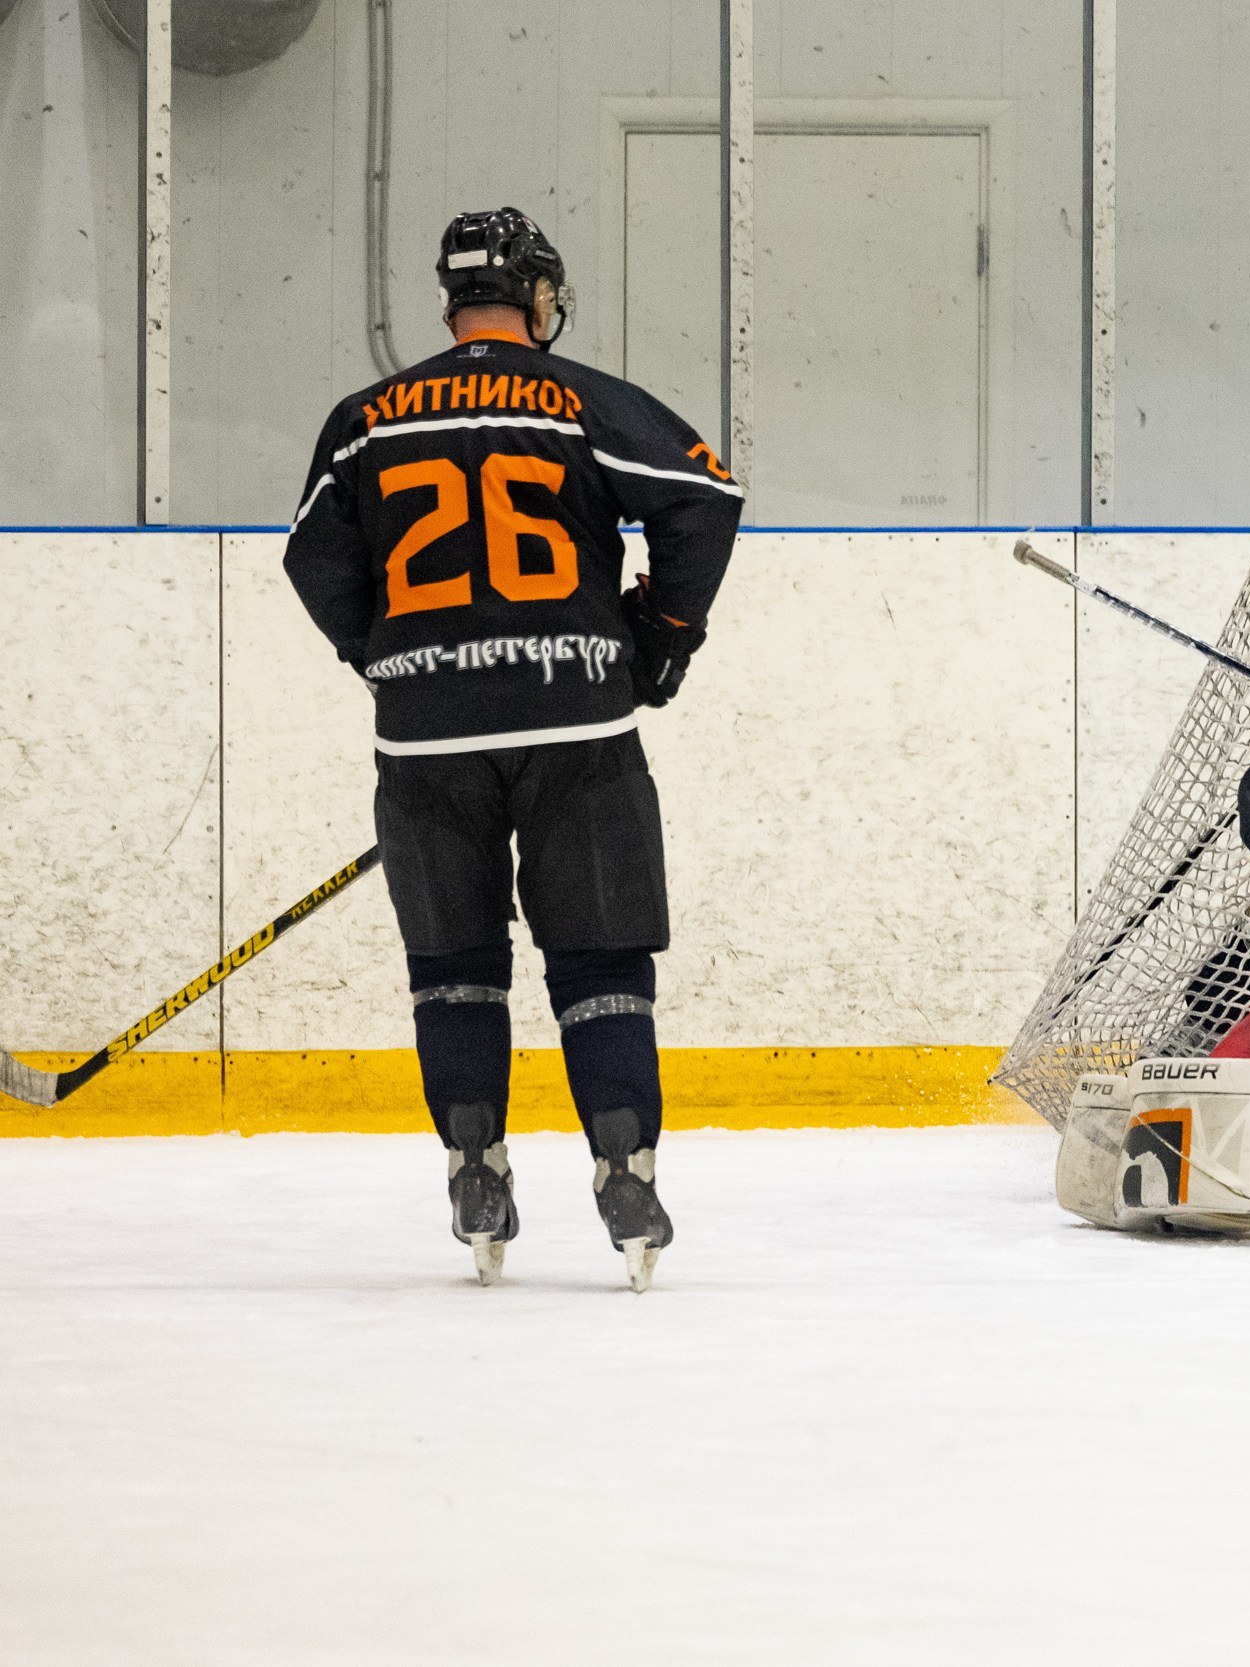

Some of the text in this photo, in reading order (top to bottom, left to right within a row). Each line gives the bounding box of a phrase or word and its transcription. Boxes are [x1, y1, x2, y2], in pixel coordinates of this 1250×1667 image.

[379, 453, 580, 619] 26
[106, 921, 276, 1063] SHERWOOD
[1080, 1081, 1114, 1096] S170
[1141, 1062, 1220, 1082] BAUER
